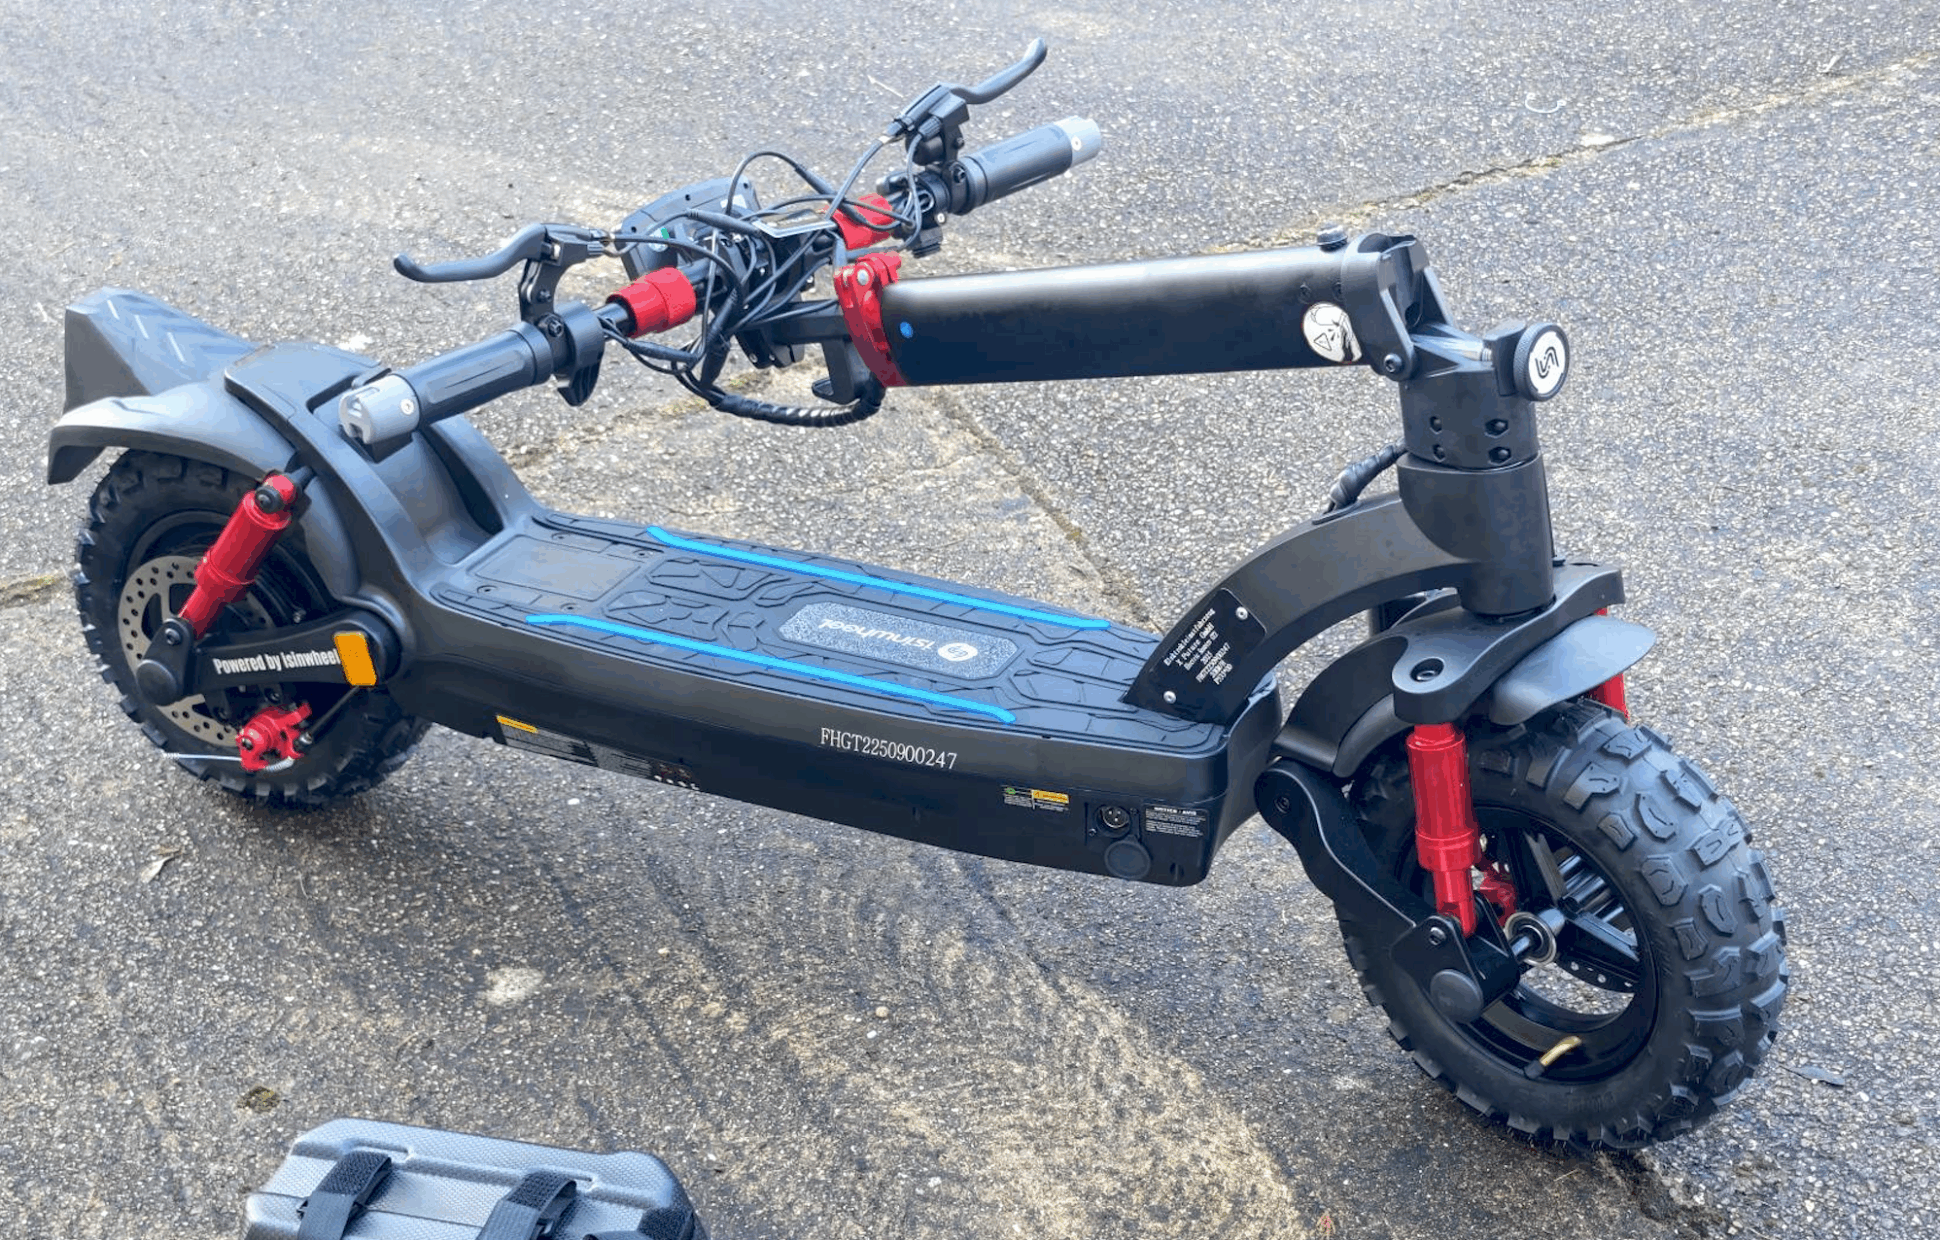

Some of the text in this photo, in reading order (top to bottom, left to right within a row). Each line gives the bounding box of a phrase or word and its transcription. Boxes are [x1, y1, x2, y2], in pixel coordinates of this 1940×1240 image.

[212, 654, 266, 675] Powered
[264, 653, 282, 672] by
[820, 727, 958, 770] FHGT2250900247
